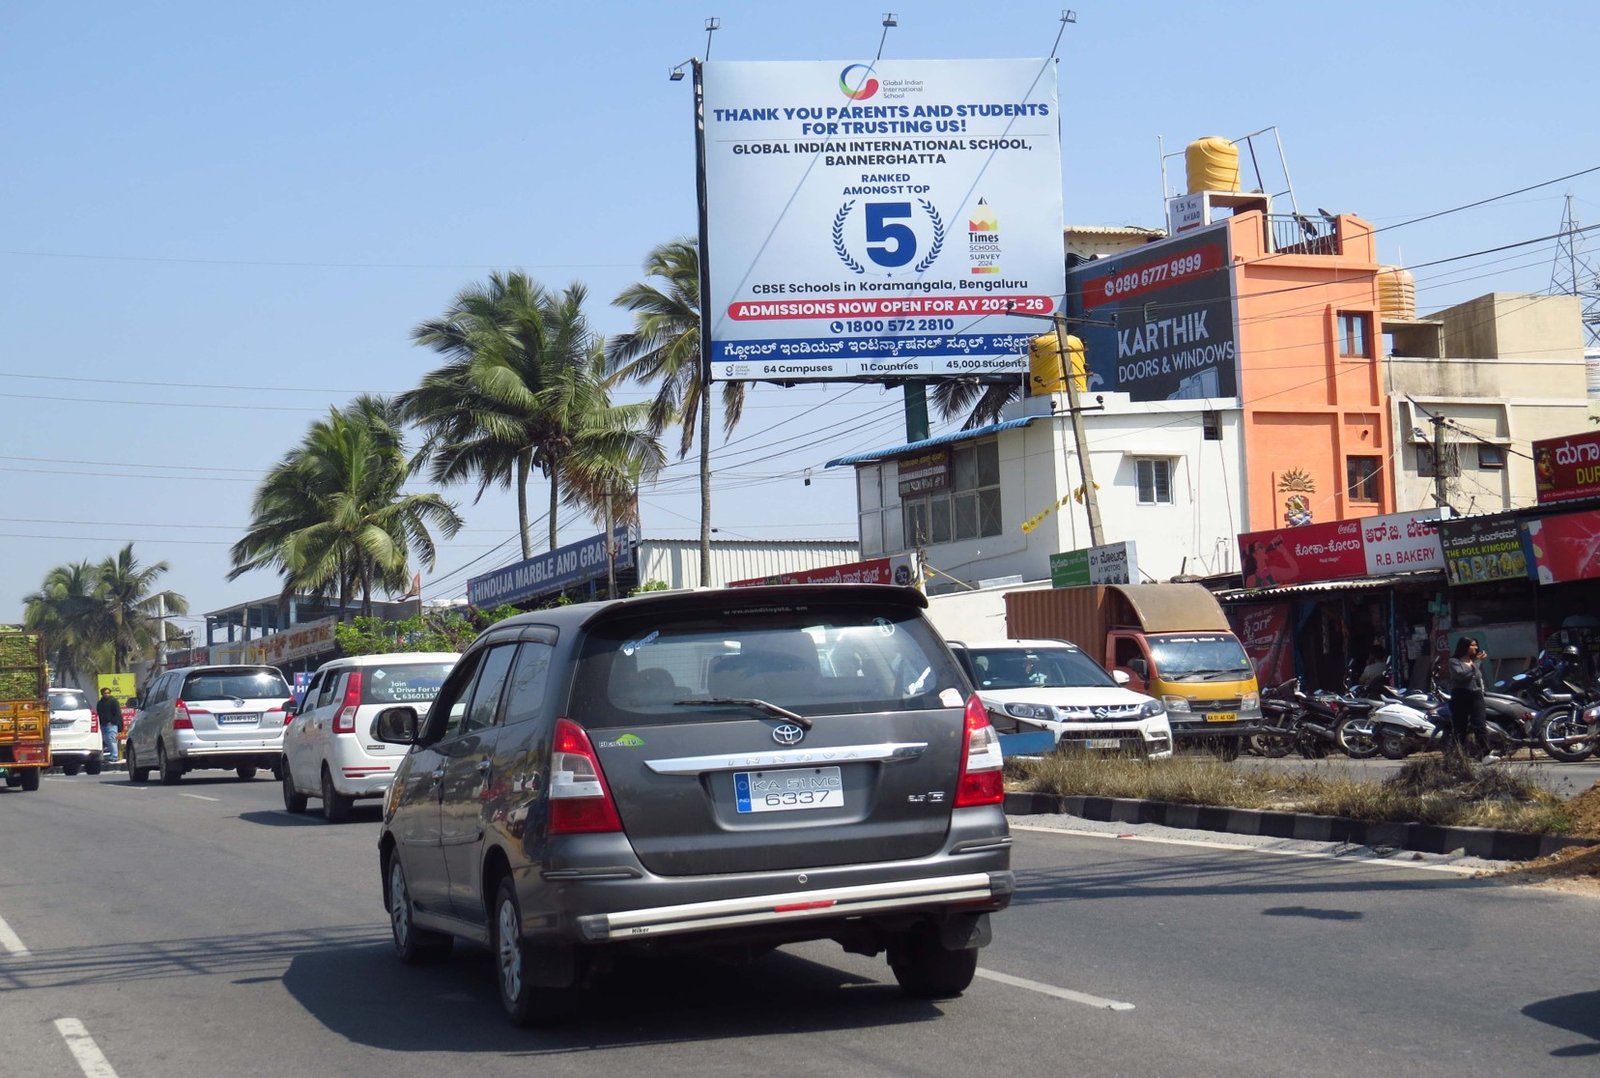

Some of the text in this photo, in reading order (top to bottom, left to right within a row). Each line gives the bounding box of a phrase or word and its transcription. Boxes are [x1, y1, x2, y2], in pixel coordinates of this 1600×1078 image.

[714, 104, 1049, 121] THANK YOU PARENTS AND STUDENTS
[803, 119, 966, 135] FOR TRUSTING US!
[733, 139, 1032, 154] GLOBAL INDIAN INTERNATIONAL SCHOOL,
[825, 153, 946, 166] BANNERGHATTA
[862, 174, 910, 182] RANKED
[843, 185, 930, 195] AMONGST TOP
[865, 202, 917, 267] 5
[968, 232, 999, 242] Times
[1115, 253, 1201, 292] 080 6777 9999
[752, 279, 1028, 294] CBSE Schools in Koramangala, Bengaluru
[738, 303, 836, 317] ADMISSIONS
[839, 301, 877, 314] NOW
[880, 300, 922, 313] OPEN
[925, 299, 953, 312] FOR
[957, 299, 979, 312] AY
[846, 318, 954, 333] 1800 572 2810
[1118, 310, 1209, 358] KARTHIK
[724, 342, 777, 360] ಗ್ಲೋಬಲ್
[780, 340, 844, 356] ಇಂಡಿಯನ್
[763, 364, 833, 375] 64 Campuses
[861, 363, 918, 371] 11 Countries
[946, 360, 1027, 370] 45,000 Students
[1119, 341, 1235, 382] DOORS & WINDOWS
[1376, 548, 1436, 566] R.B. BAKERY
[1445, 541, 1520, 558] THE ROLL KINGDOM
[475, 532, 628, 600] HINDUJA MARBLE AND GRANTE
[753, 781, 781, 791] KA
[786, 778, 806, 789] 51
[765, 790, 829, 806] 6337
